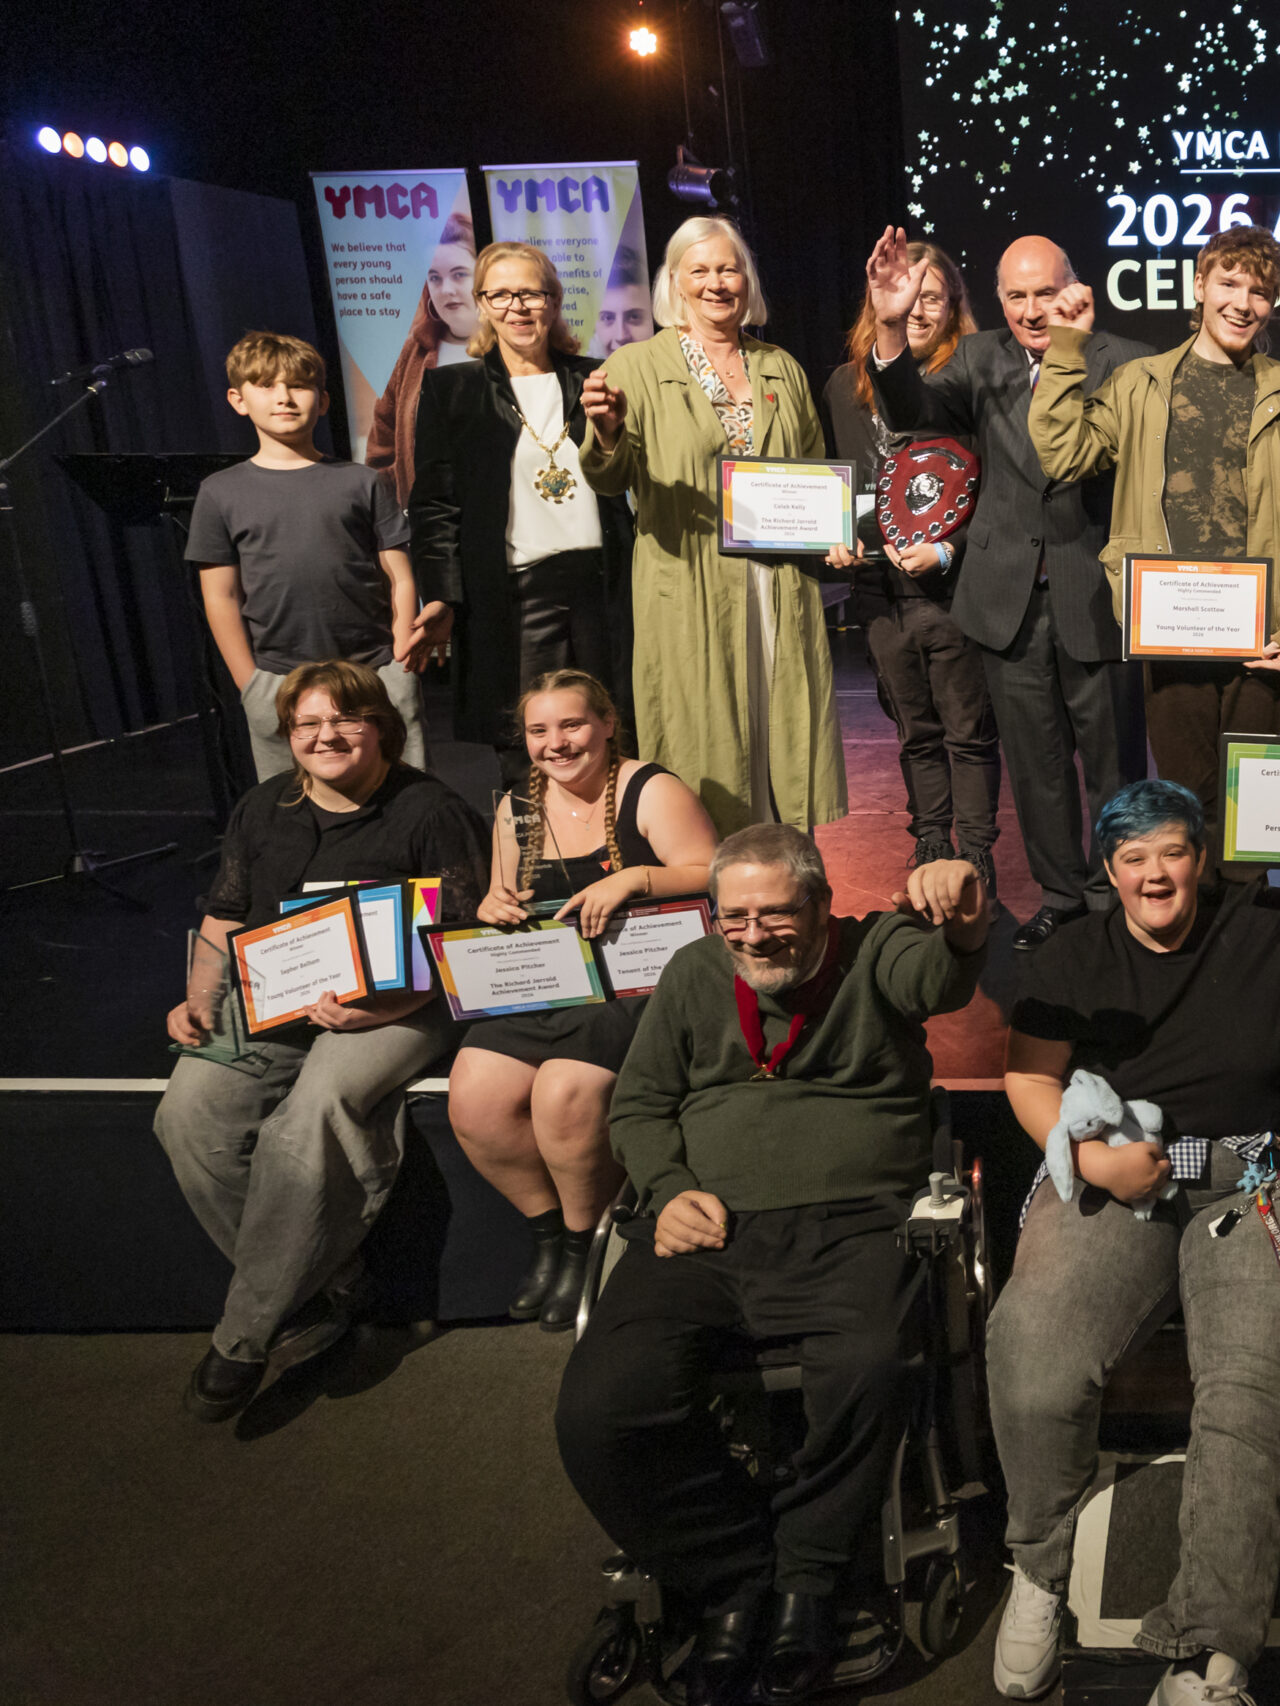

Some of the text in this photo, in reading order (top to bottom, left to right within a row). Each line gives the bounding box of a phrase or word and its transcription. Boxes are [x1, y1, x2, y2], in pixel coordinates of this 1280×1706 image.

[1172, 130, 1270, 161] YMCA
[496, 175, 610, 213] YMCA
[324, 182, 439, 219] YMCA
[1106, 193, 1253, 246] 2026
[331, 243, 406, 252] We believe that
[556, 238, 598, 247] everyone
[552, 254, 571, 262] able
[333, 261, 391, 270] every young
[593, 269, 602, 277] of
[336, 274, 402, 287] person should
[337, 291, 358, 300] have
[370, 290, 391, 300] safe
[339, 307, 362, 319] place
[379, 308, 400, 319] stay
[1156, 624, 1175, 632] Young
[272, 922, 292, 934] YMCA
[639, 920, 682, 930] Achievement
[260, 942, 288, 955] Certificate
[296, 927, 330, 942] Achievement
[467, 945, 504, 954] Certificate
[515, 939, 560, 948] Achievement
[267, 992, 284, 1000] Young
[285, 983, 311, 994] Volunteer
[492, 987, 536, 995] Achievement
